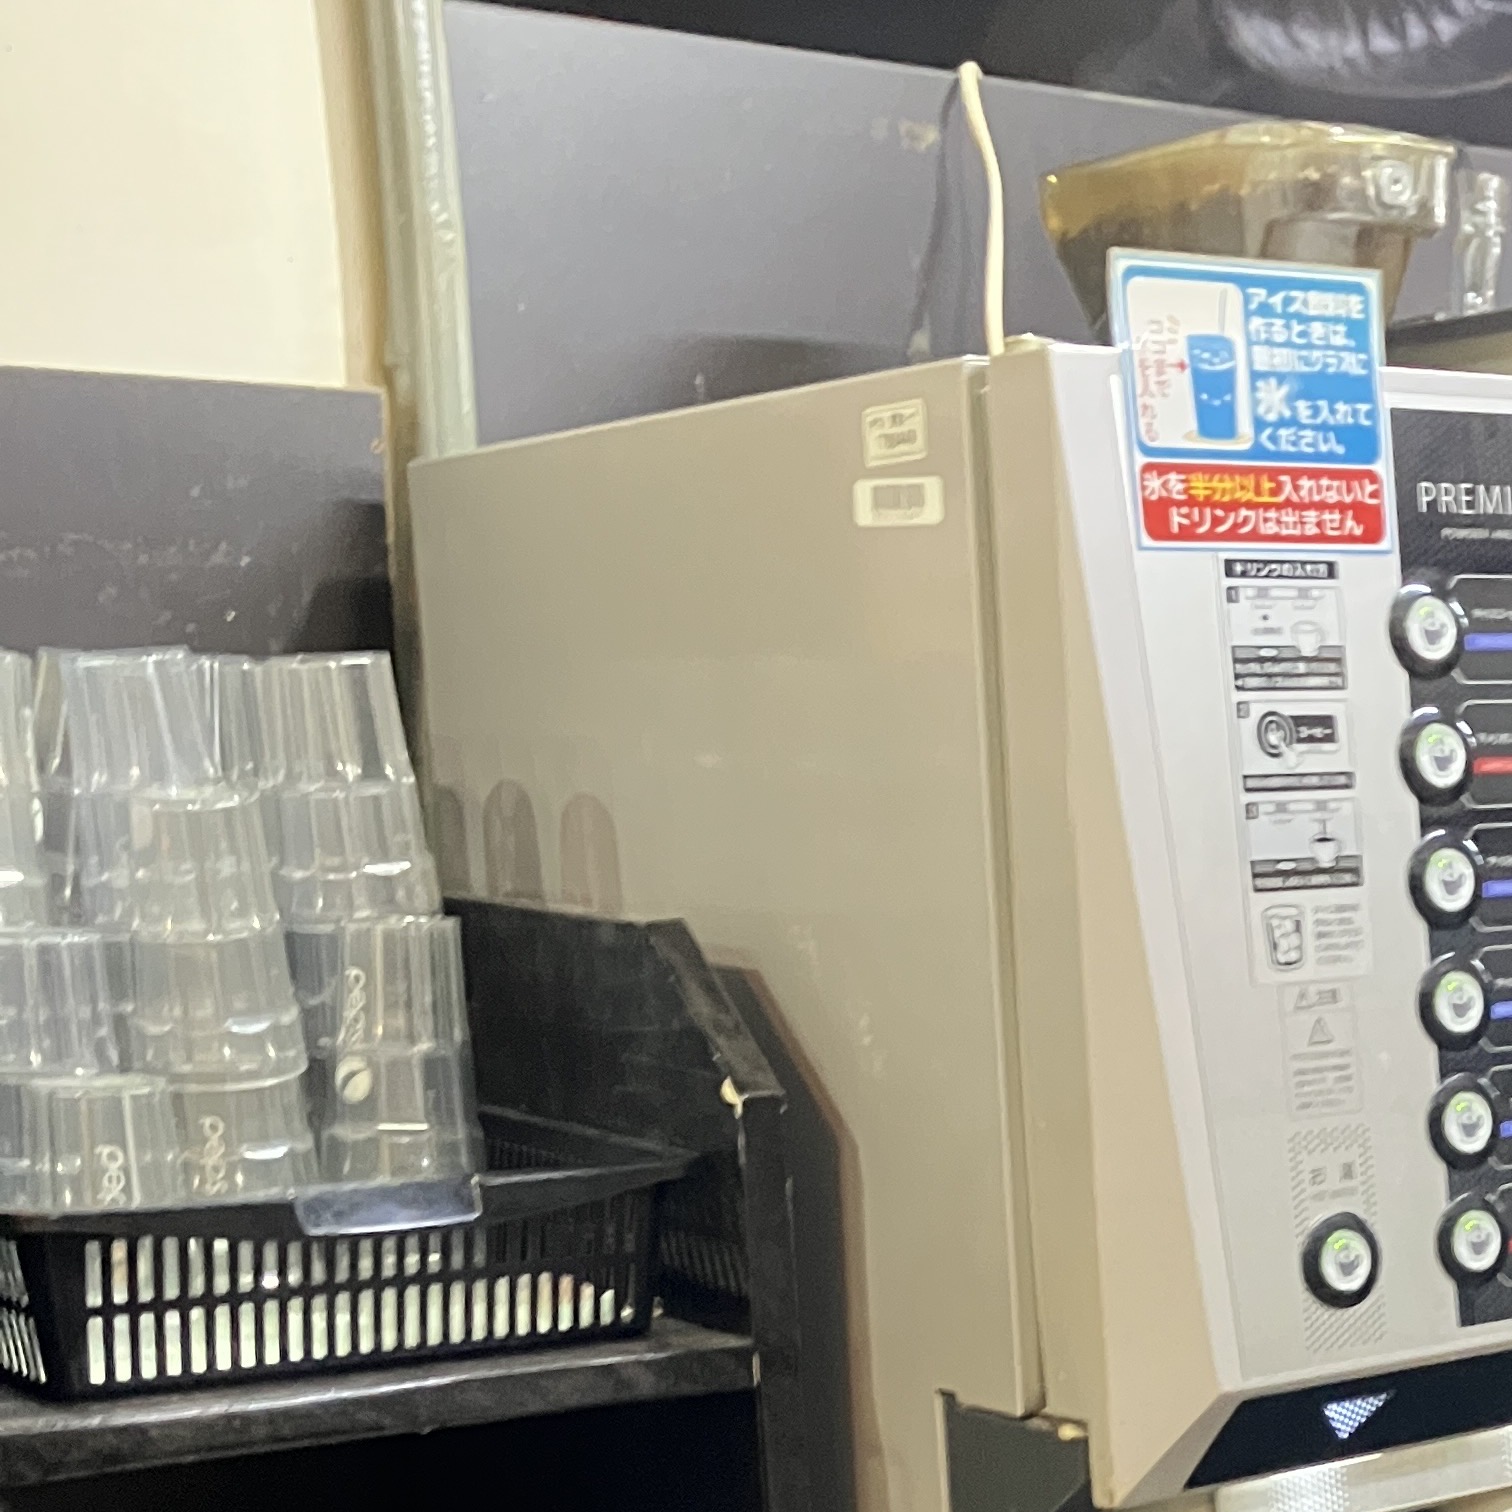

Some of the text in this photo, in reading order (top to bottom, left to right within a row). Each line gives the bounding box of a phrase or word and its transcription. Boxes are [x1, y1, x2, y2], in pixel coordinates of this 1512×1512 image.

[1142, 469, 1381, 505] 氷を半分以上入れないと
[1168, 506, 1364, 537] ドリンクは出ません
